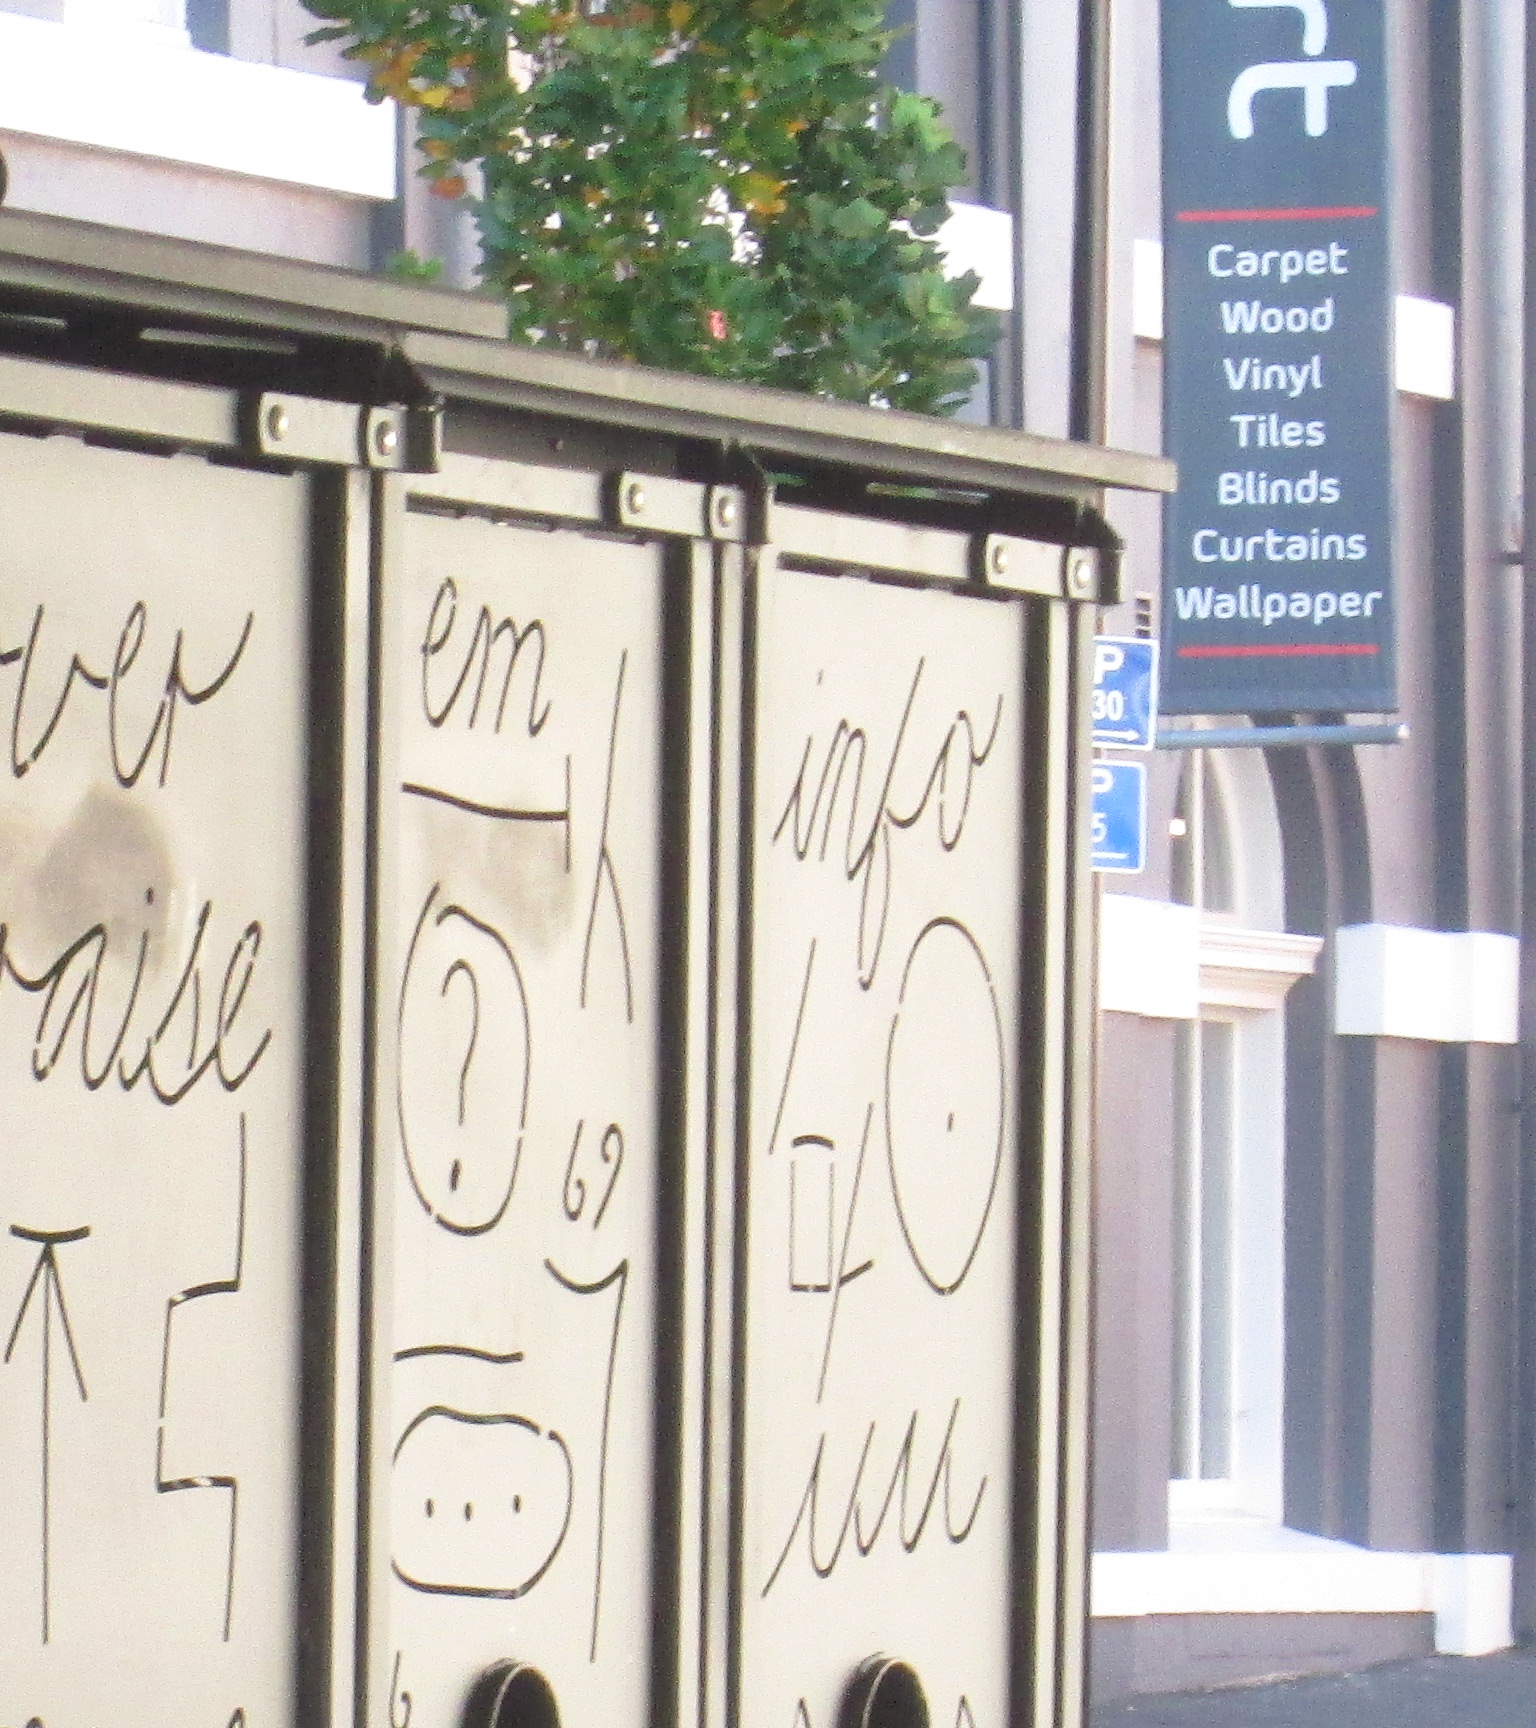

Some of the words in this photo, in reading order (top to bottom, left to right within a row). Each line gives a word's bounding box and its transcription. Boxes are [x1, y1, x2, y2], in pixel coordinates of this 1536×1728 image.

[1207, 242, 1349, 283] Carpet
[1220, 298, 1337, 334] Wood
[1222, 355, 1324, 399] Vinyl
[1229, 412, 1328, 449] Tiles
[1218, 470, 1342, 506] Blinds
[1192, 529, 1368, 564] Curtains
[1175, 584, 1383, 627] Wallpaper
[422, 576, 552, 737] em
[1093, 644, 1125, 686] P
[1092, 689, 1125, 722] 30
